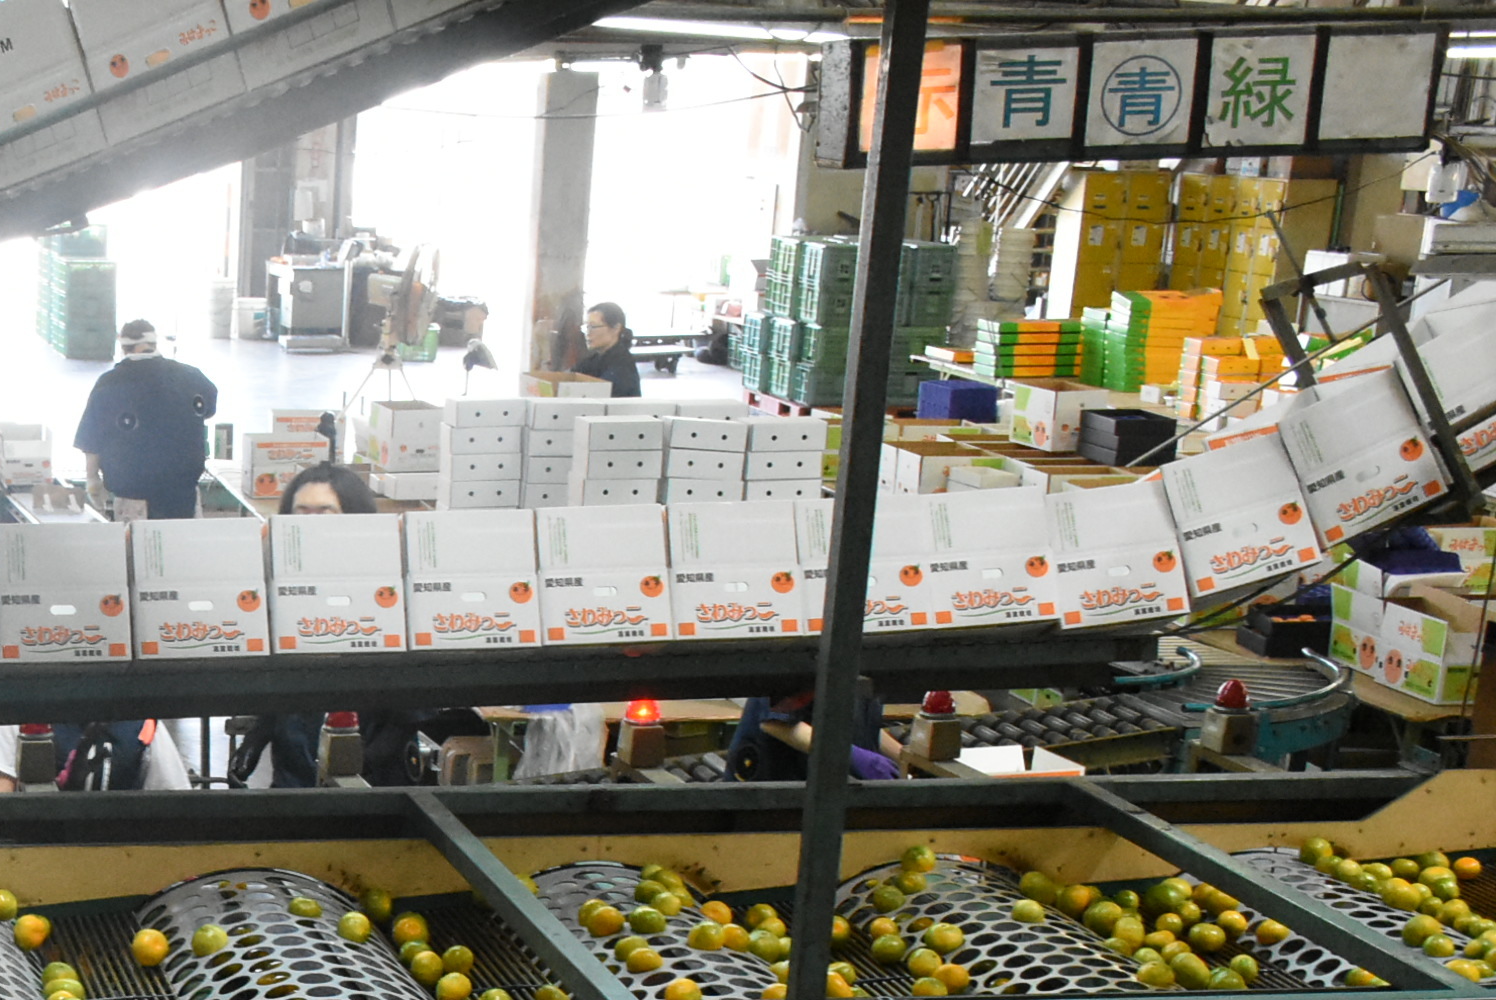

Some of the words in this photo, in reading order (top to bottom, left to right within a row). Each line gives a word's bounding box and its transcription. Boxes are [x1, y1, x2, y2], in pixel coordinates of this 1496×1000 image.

[0, 37, 14, 54] M
[990, 54, 1068, 128] 青
[1108, 66, 1174, 128] 青
[1219, 57, 1296, 128] 緑
[1307, 470, 1345, 494] 愛知県産
[1336, 474, 1419, 522] さわみっこ
[1183, 523, 1223, 542] 愛知県産
[1209, 536, 1295, 574] さわみっこ
[930, 560, 969, 573] 愛知県産
[1057, 559, 1096, 573] 愛知県産
[413, 582, 452, 593] 愛知県産
[544, 577, 584, 588] 愛知県産
[676, 572, 715, 584] 愛知県産
[1, 594, 40, 605] 愛知県産
[139, 590, 178, 601] 愛知県産
[278, 586, 317, 597] 愛知県産
[952, 587, 1035, 611] さわみっこ
[1080, 582, 1164, 610] さわみっこ
[432, 611, 517, 633] さわみっこ
[565, 606, 649, 628] さわみっこ
[695, 602, 780, 623] さわみっこ
[21, 625, 107, 646] さわみっこ
[159, 620, 245, 643] さわみっこ
[297, 615, 382, 637] さわみっこ
